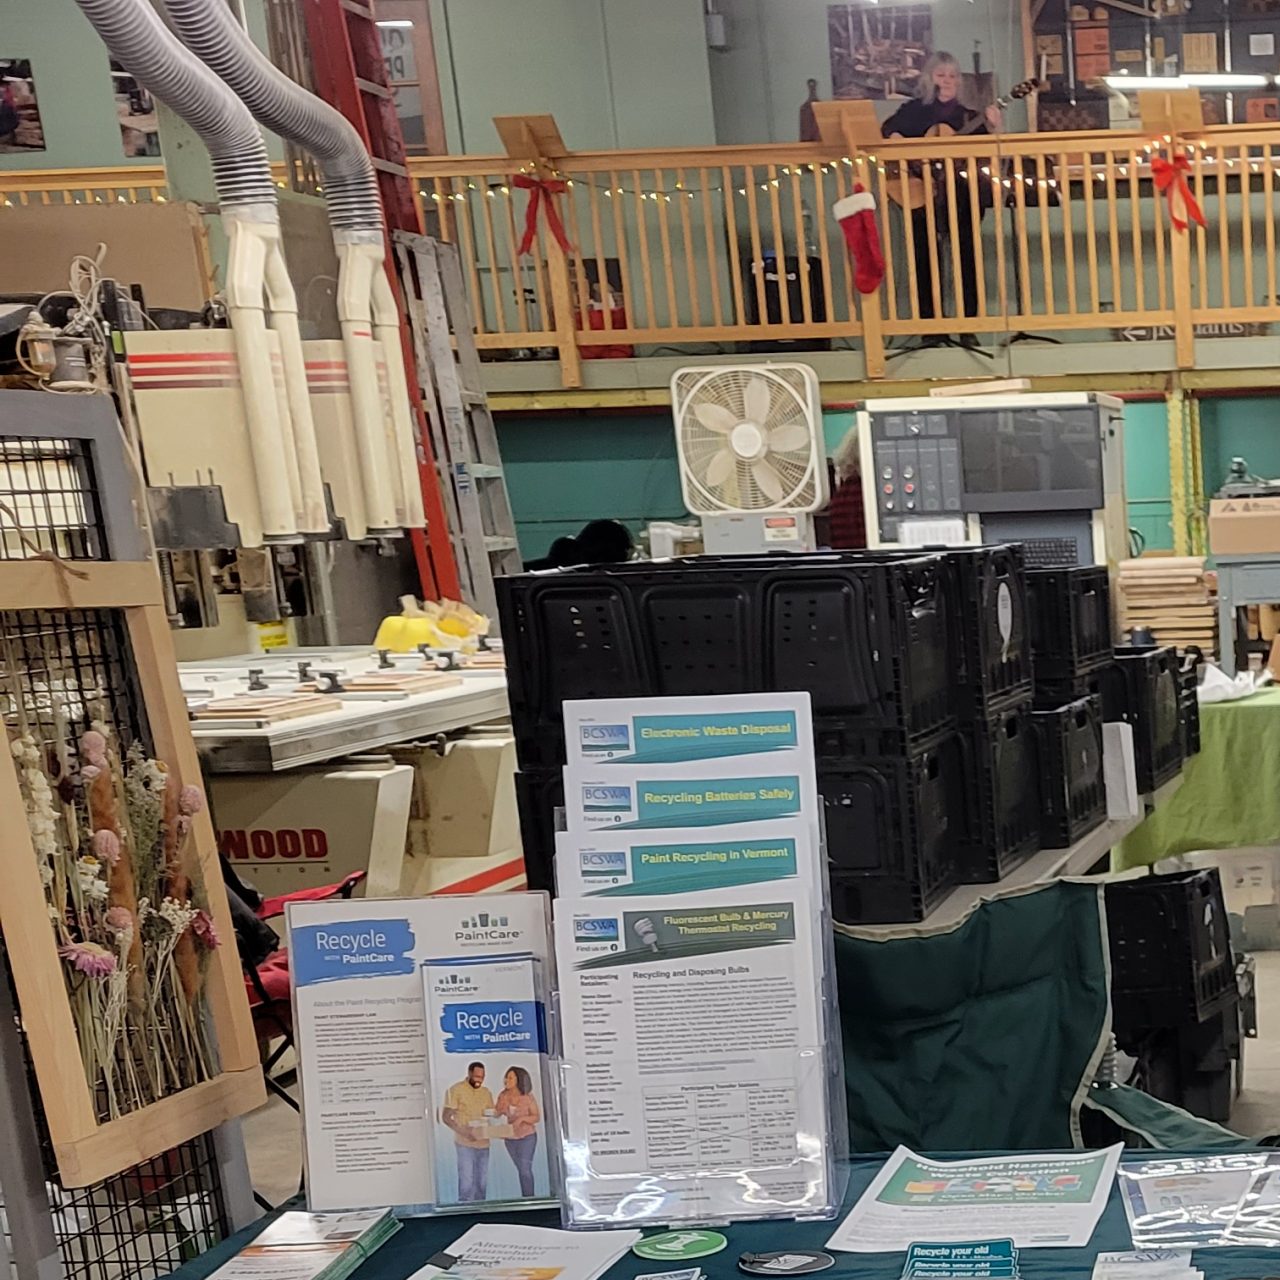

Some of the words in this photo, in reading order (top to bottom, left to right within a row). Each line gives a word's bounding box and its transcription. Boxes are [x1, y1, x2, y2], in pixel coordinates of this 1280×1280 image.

[583, 726, 626, 739] BCSWA
[641, 727, 701, 739] Electronic
[703, 726, 739, 737] Waste
[741, 723, 792, 737] Disposal
[585, 789, 628, 800] BCSWA
[644, 792, 702, 805] Recycling
[706, 791, 756, 802] Batteries
[759, 789, 795, 801] Safely
[583, 855, 625, 865] BCSWA
[641, 854, 671, 864] Paint
[673, 851, 727, 863] Recycling
[729, 851, 740, 861] in
[743, 848, 788, 860] Vermont
[576, 920, 615, 931] BCSWA
[664, 913, 718, 925] Fluorescent
[720, 911, 741, 922] Bulb
[743, 911, 750, 920] &
[753, 910, 789, 922] Mercury
[455, 929, 520, 941] PaintCare
[678, 923, 731, 936] Thermostat
[732, 921, 777, 933] Recycling
[316, 929, 386, 953] Recycle
[342, 953, 395, 964] PaintCare
[580, 974, 619, 982] Participating
[632, 970, 671, 980] Recycling
[672, 969, 687, 977] and
[688, 968, 726, 979] Disposing
[728, 966, 750, 974] Bulbs
[434, 984, 478, 993] PaintCare
[364, 999, 396, 1009] Recycling
[456, 1010, 524, 1033] Recycle
[483, 1031, 531, 1044] PaintCare
[916, 1163, 1005, 1173] Household
[1008, 1159, 1095, 1169] Hazardous
[986, 1168, 1069, 1177] Collection
[914, 1247, 950, 1257] Recycle
[952, 1247, 973, 1258] your
[974, 1246, 989, 1254] old
